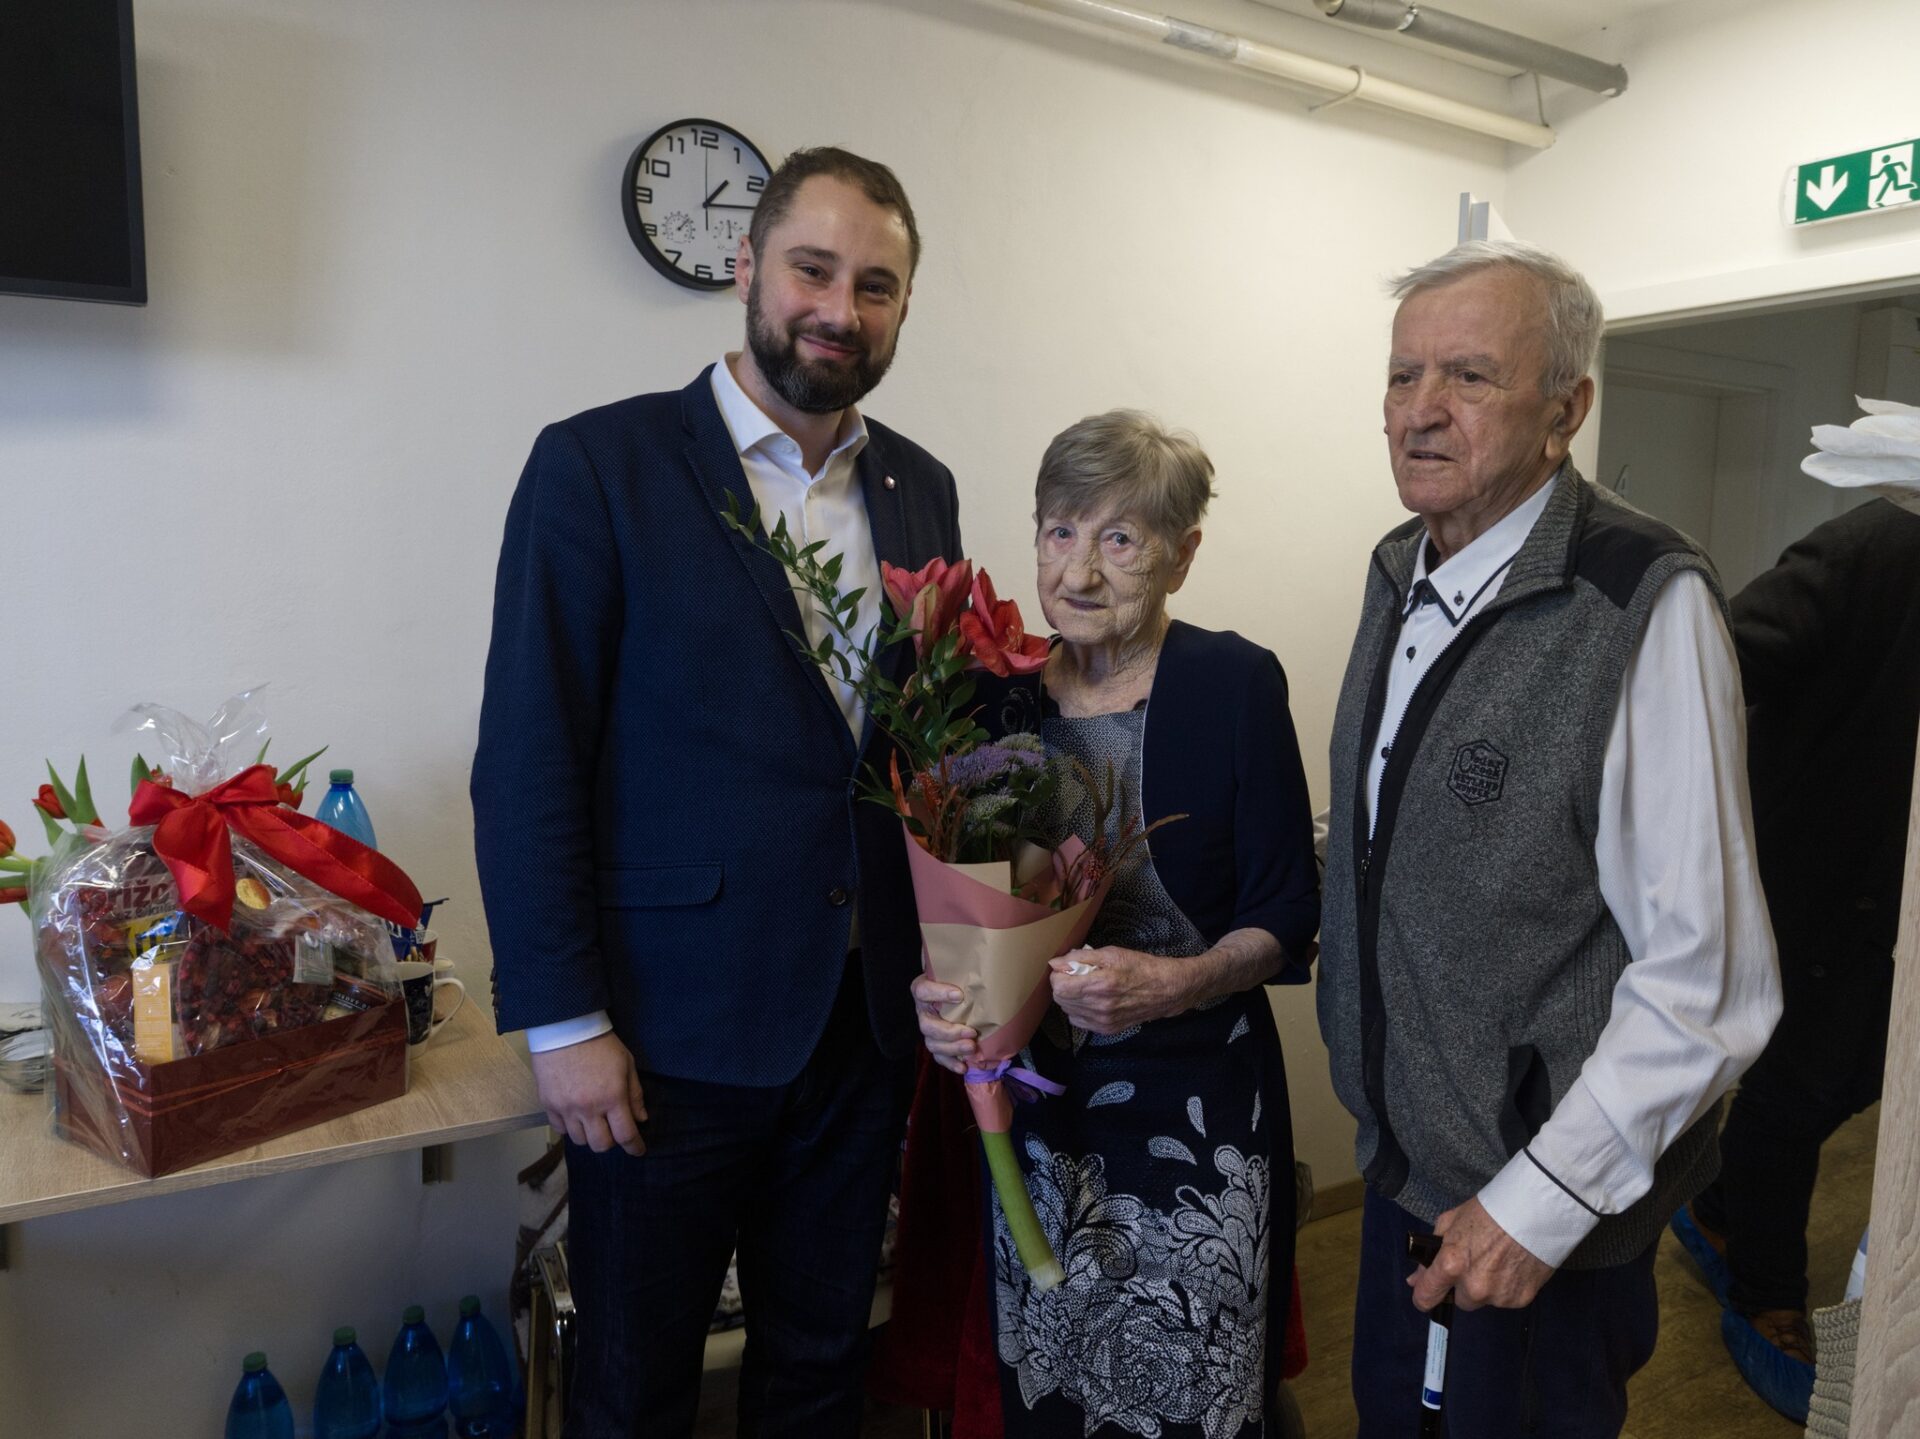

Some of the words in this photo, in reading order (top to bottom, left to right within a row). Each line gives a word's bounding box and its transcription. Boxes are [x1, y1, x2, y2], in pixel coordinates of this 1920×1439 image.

[666, 135, 684, 154] 11
[691, 128, 719, 149] 12
[733, 147, 740, 164] 1
[643, 157, 670, 178] 10
[746, 175, 764, 193] 2
[636, 186, 652, 204] 9
[665, 249, 682, 266] 7
[695, 264, 713, 280] 6
